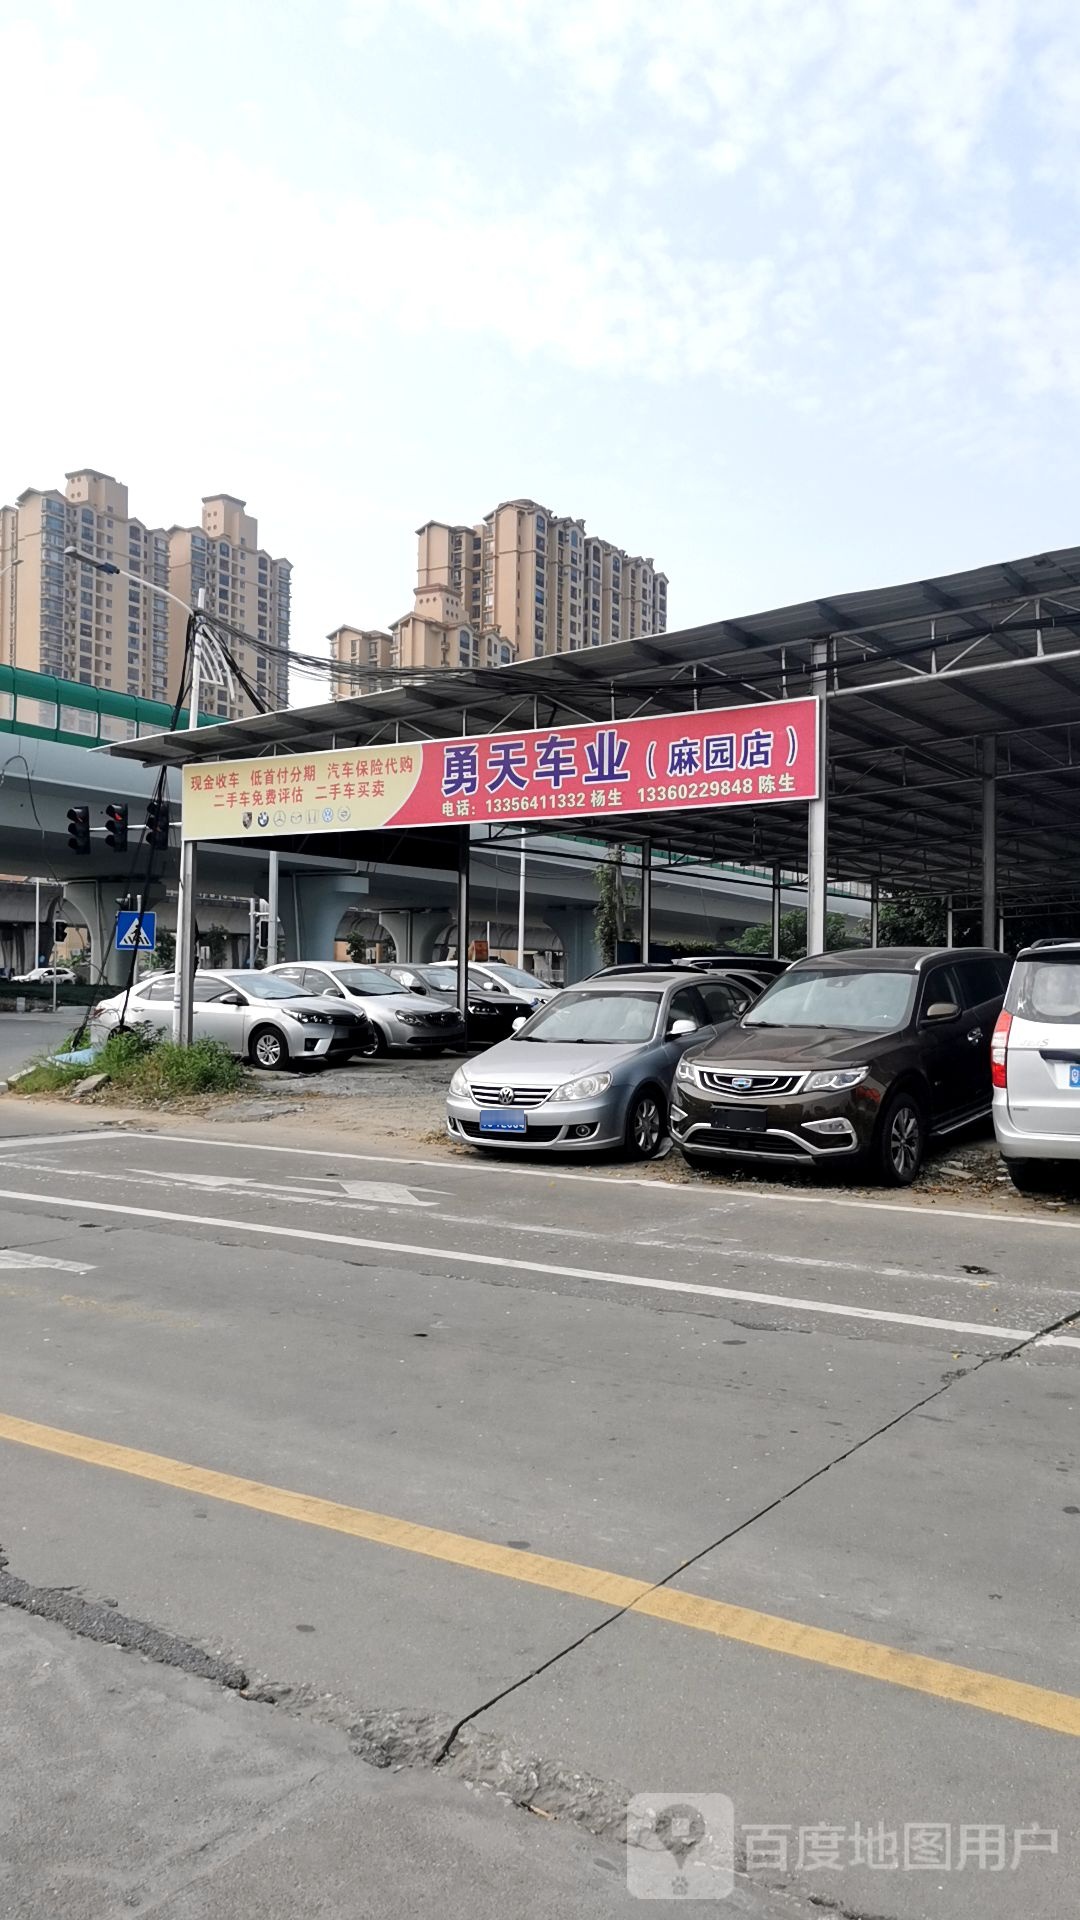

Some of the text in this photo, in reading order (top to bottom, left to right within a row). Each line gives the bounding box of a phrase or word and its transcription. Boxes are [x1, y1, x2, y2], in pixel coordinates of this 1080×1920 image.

[190, 755, 414, 792] 现金收车 低首付分期 汽车保险代购
[213, 780, 385, 809] 二手车免费评估 二手车买卖
[485, 790, 586, 814] 13356411332
[590, 789, 623, 808] 杨生
[637, 778, 753, 804] 13360229848
[758, 771, 796, 794] 陈生
